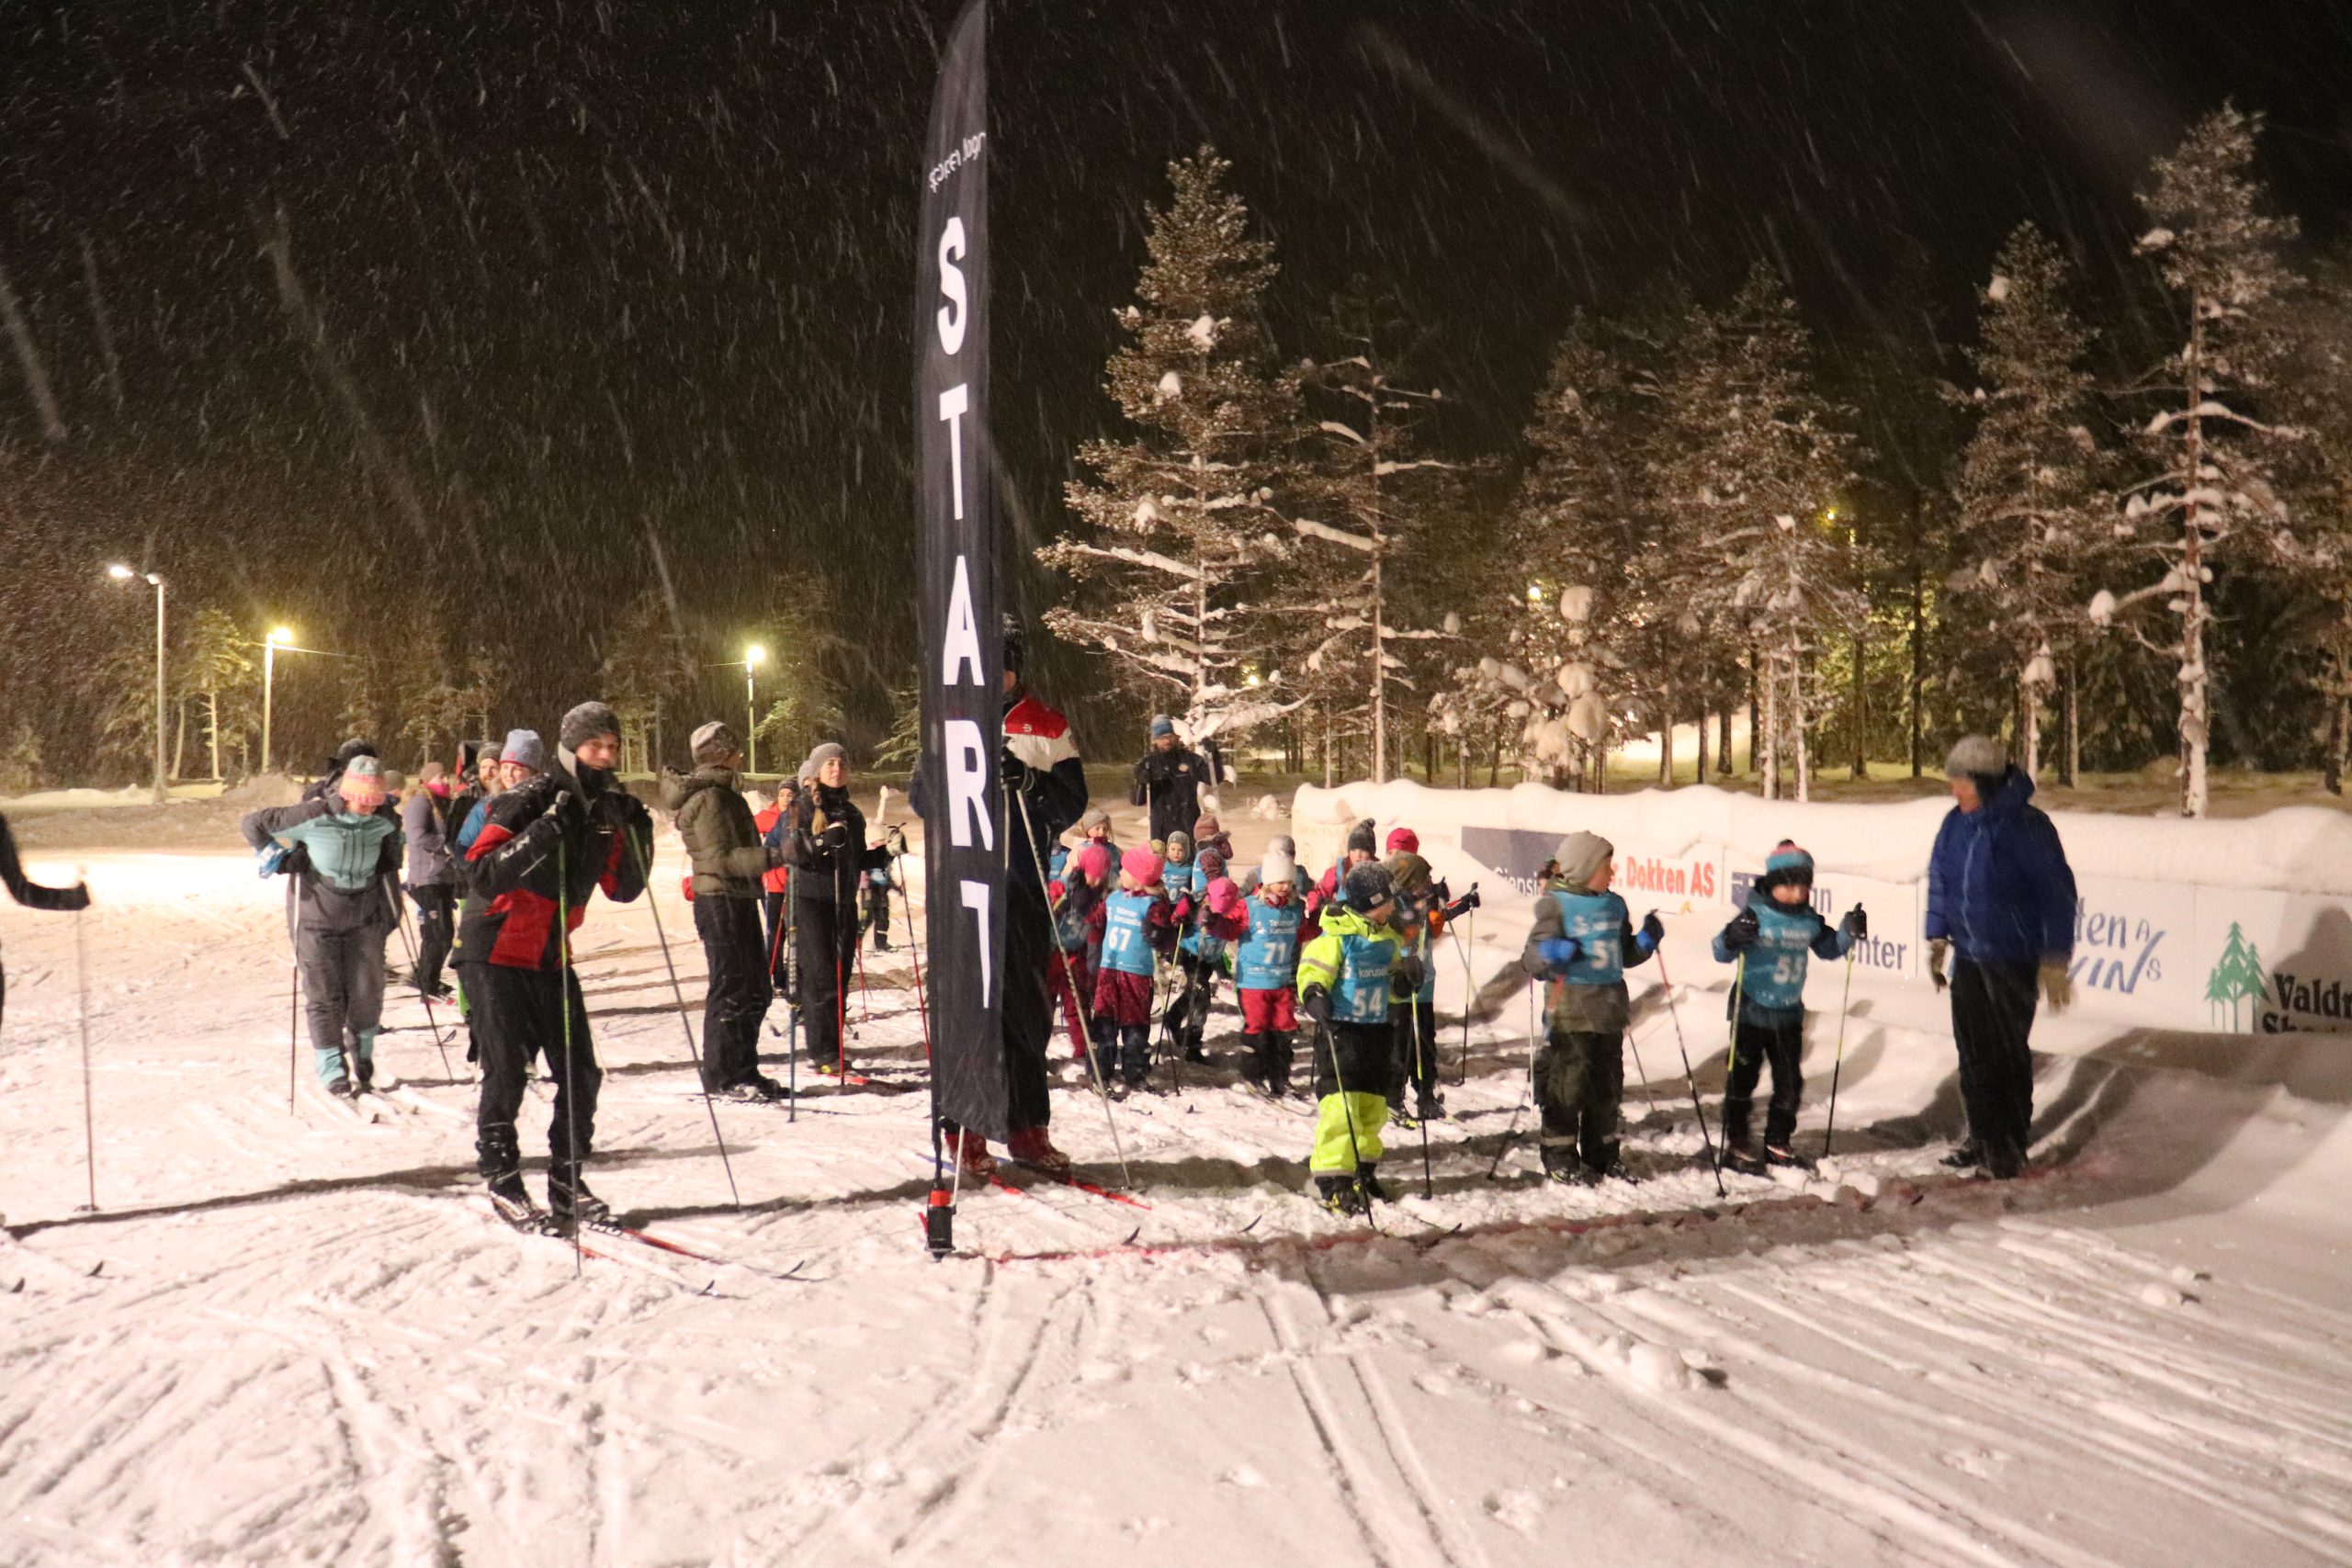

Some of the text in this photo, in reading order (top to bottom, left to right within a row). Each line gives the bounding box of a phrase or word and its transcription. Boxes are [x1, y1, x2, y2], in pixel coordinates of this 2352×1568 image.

[937, 217, 993, 1009] START
[1626, 856, 1685, 895] Dokken
[1690, 862, 1714, 897] AS
[1108, 925, 1132, 952] 67
[1263, 942, 1286, 964] 71
[1352, 987, 1383, 1017] 54
